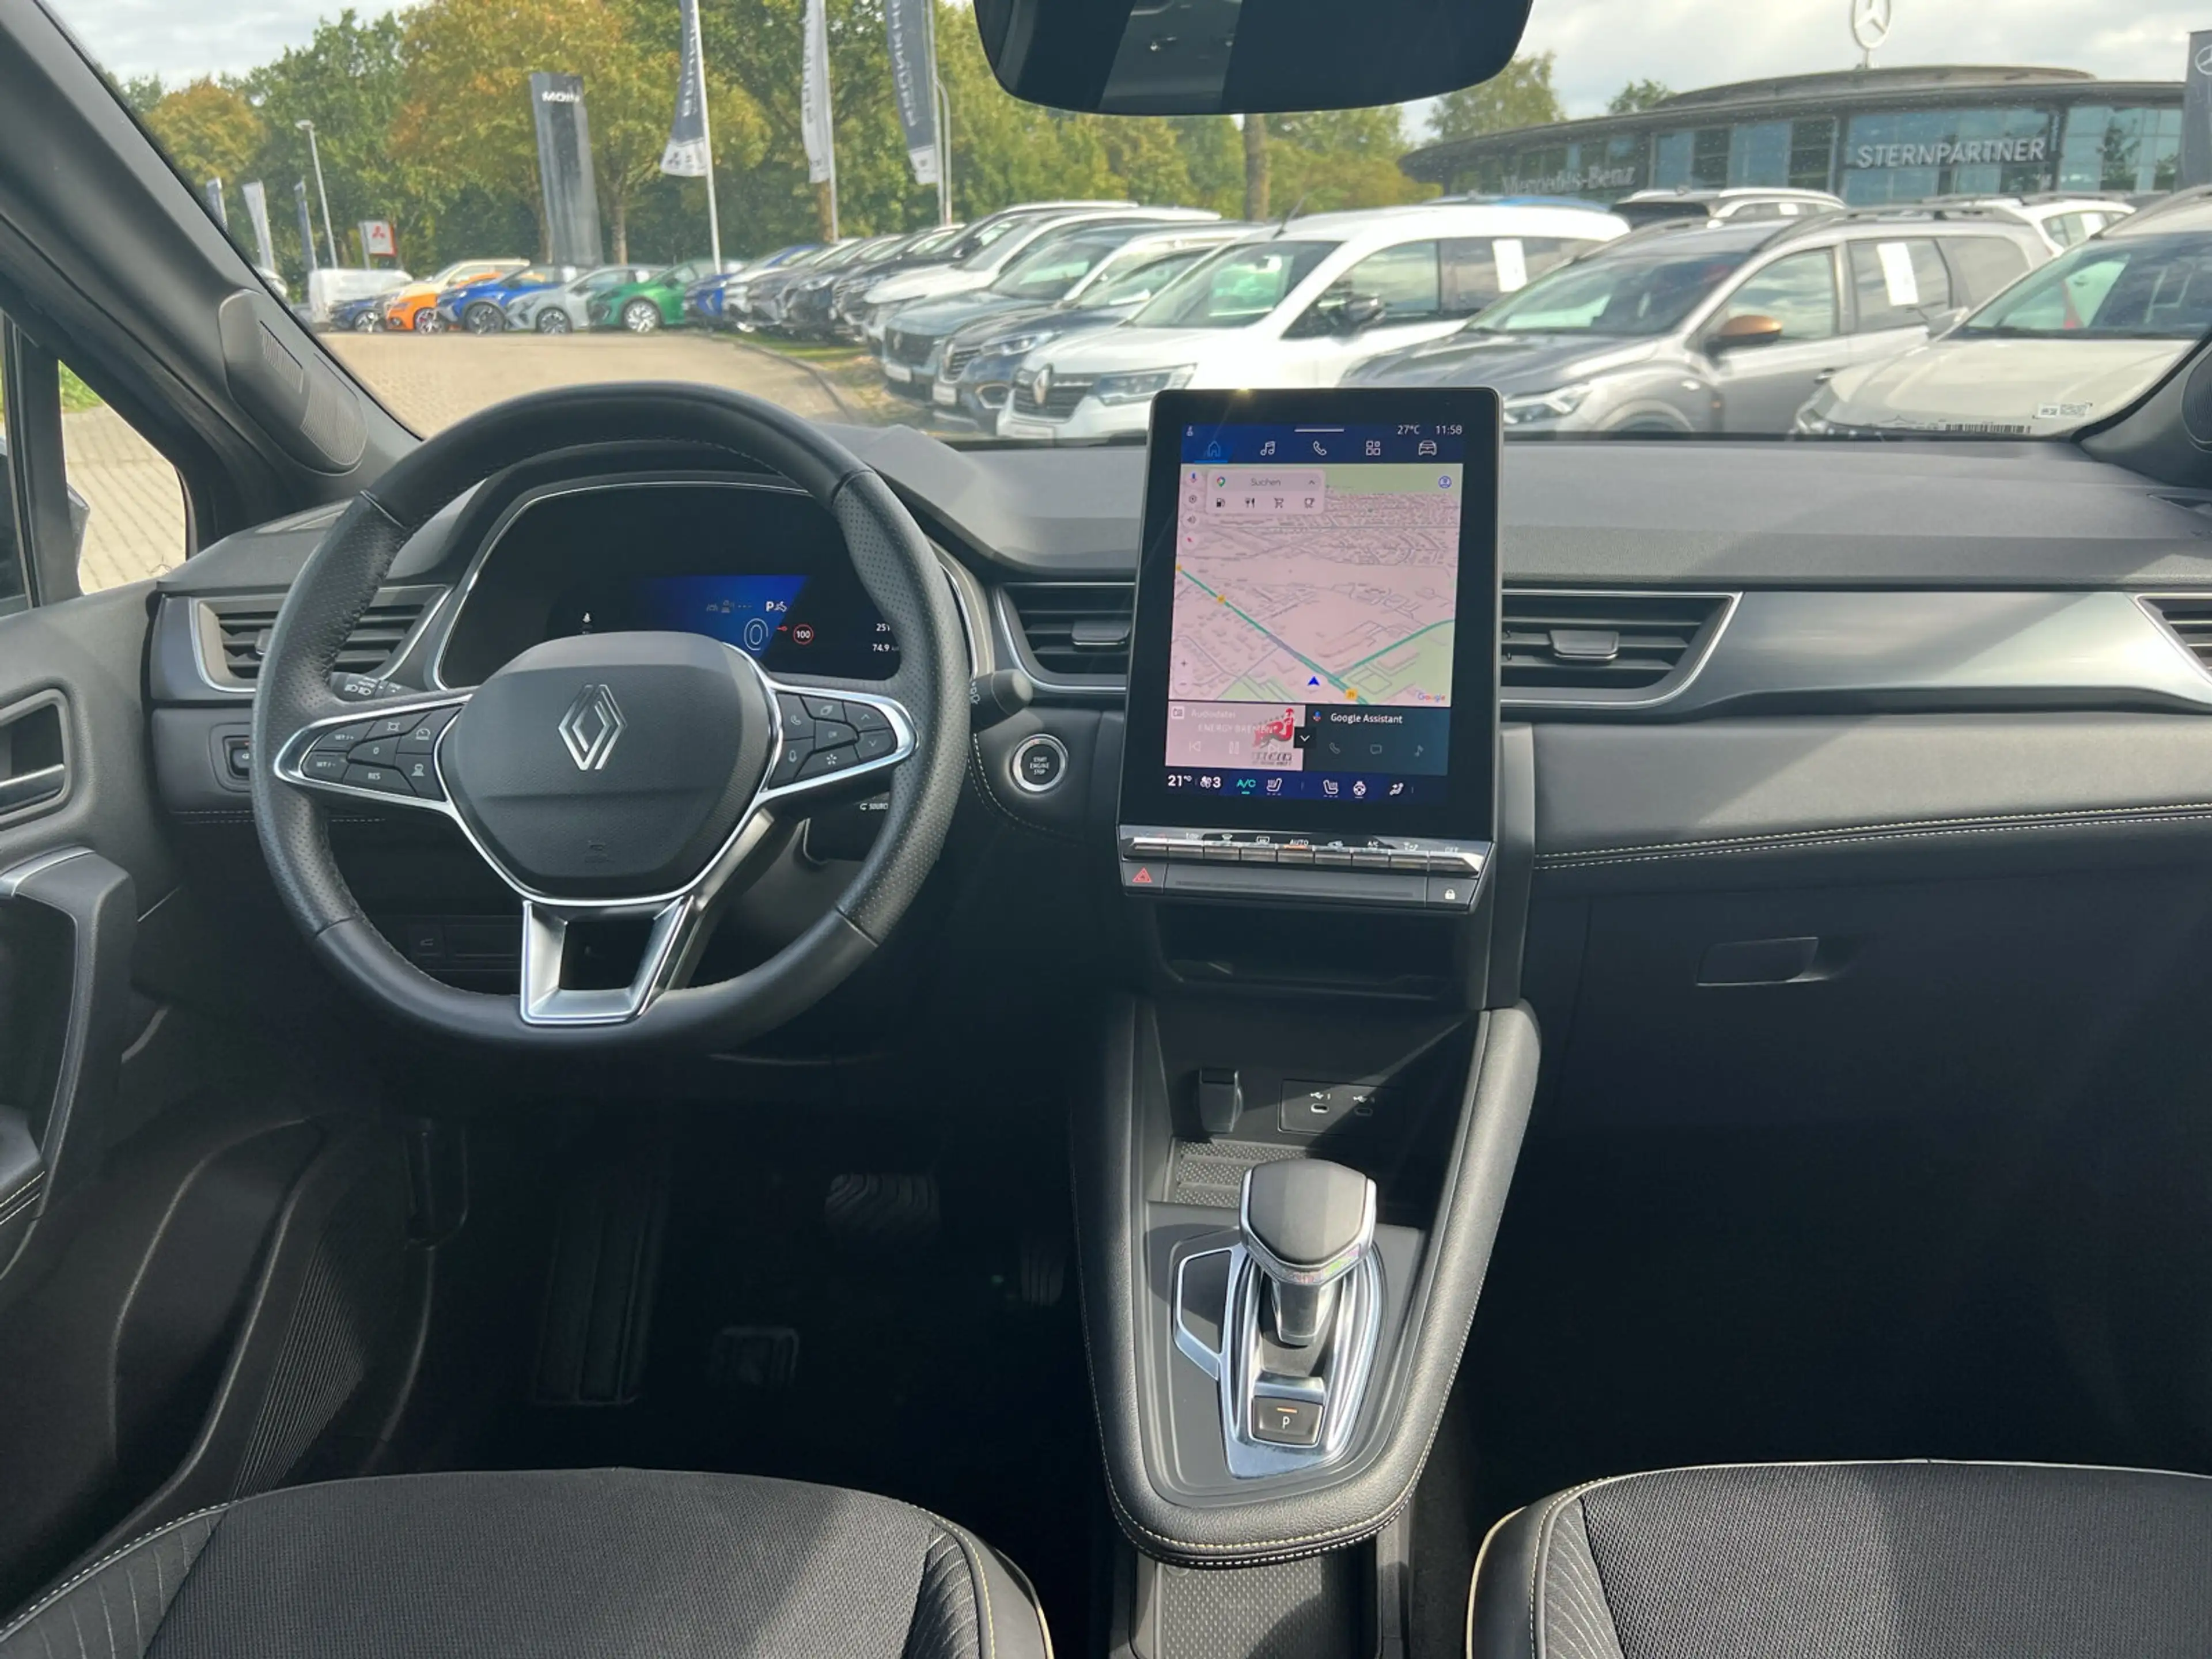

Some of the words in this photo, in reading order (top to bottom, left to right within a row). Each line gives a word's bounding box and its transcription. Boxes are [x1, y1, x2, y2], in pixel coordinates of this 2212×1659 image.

[1857, 138, 2045, 168] STERNPARTNER
[1397, 425, 1421, 435] 27°C
[1435, 425, 1463, 435] 11:58
[1251, 477, 1281, 486] Suchen
[766, 601, 774, 612] P
[796, 630, 811, 639] 100
[1331, 713, 1361, 724] Google
[1363, 714, 1403, 724] Assistant
[1213, 777, 1221, 788] 3
[1236, 779, 1256, 789] A/C
[1282, 1415, 1290, 1429] P
